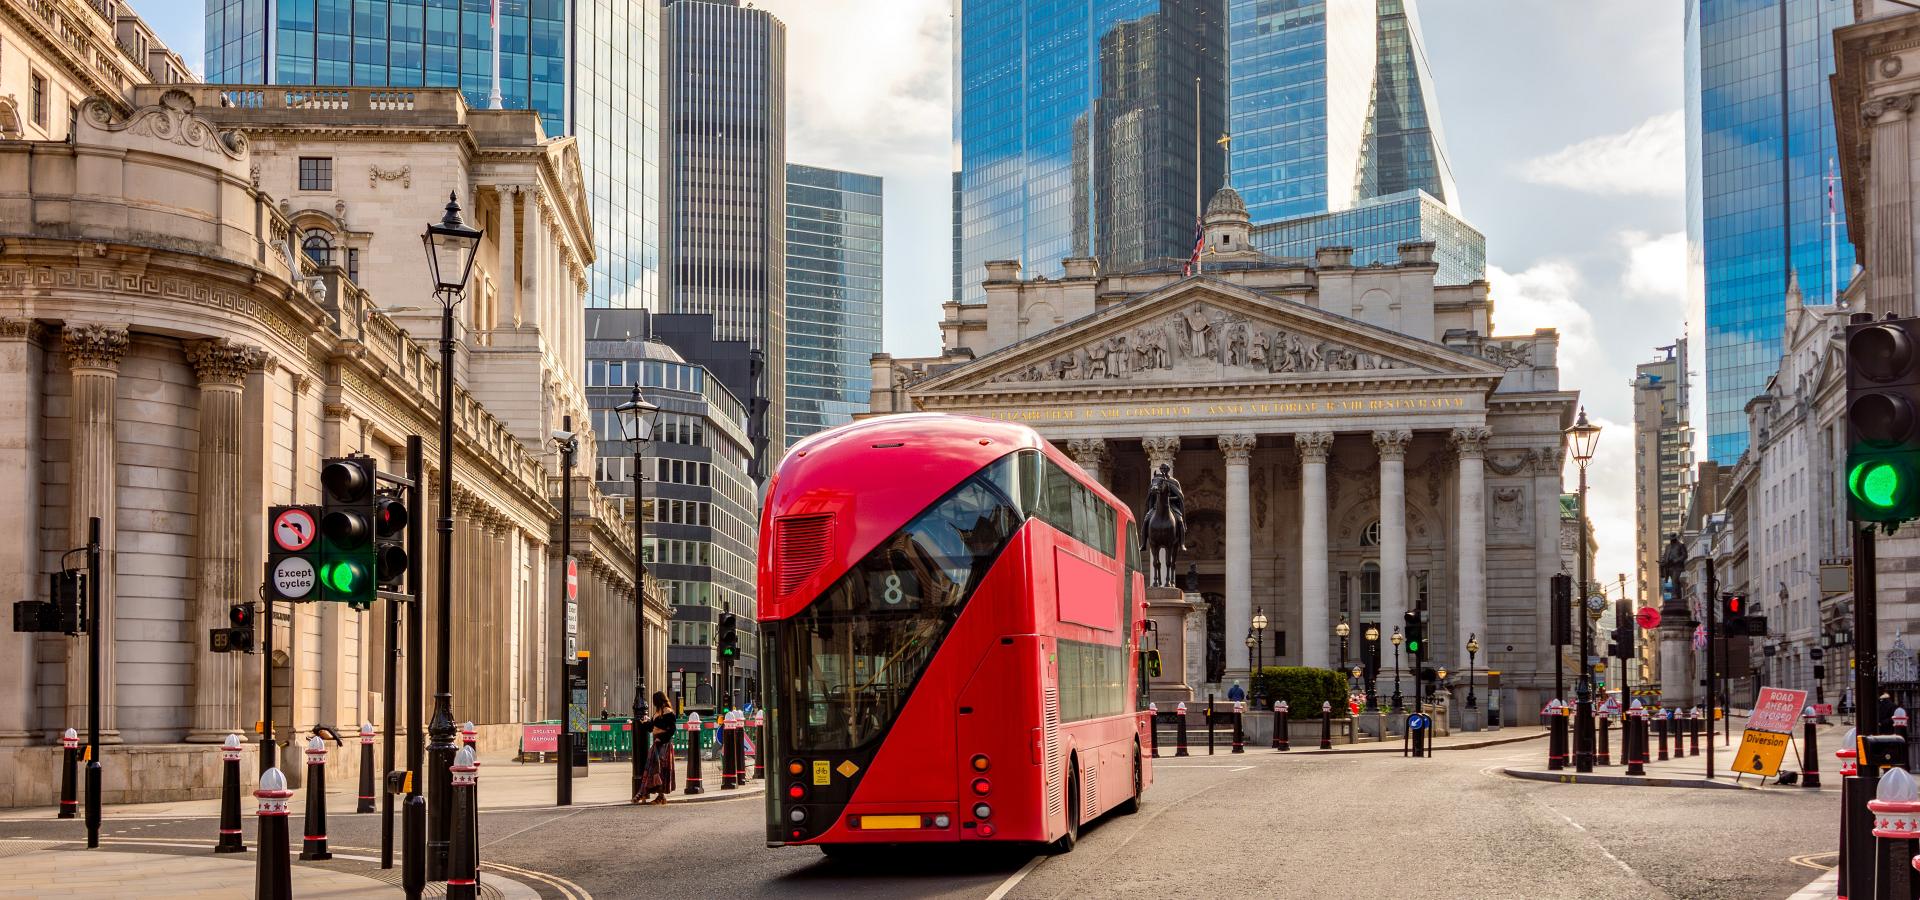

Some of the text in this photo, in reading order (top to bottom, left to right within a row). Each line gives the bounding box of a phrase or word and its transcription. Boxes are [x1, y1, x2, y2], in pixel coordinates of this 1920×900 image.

[278, 568, 312, 579] Except
[279, 579, 311, 589] cycles
[885, 575, 902, 604] 8
[1770, 692, 1794, 702] ROAD
[1765, 702, 1794, 712] AHEAD
[1759, 711, 1792, 721] CLOSED
[1746, 733, 1784, 747] Diversion
